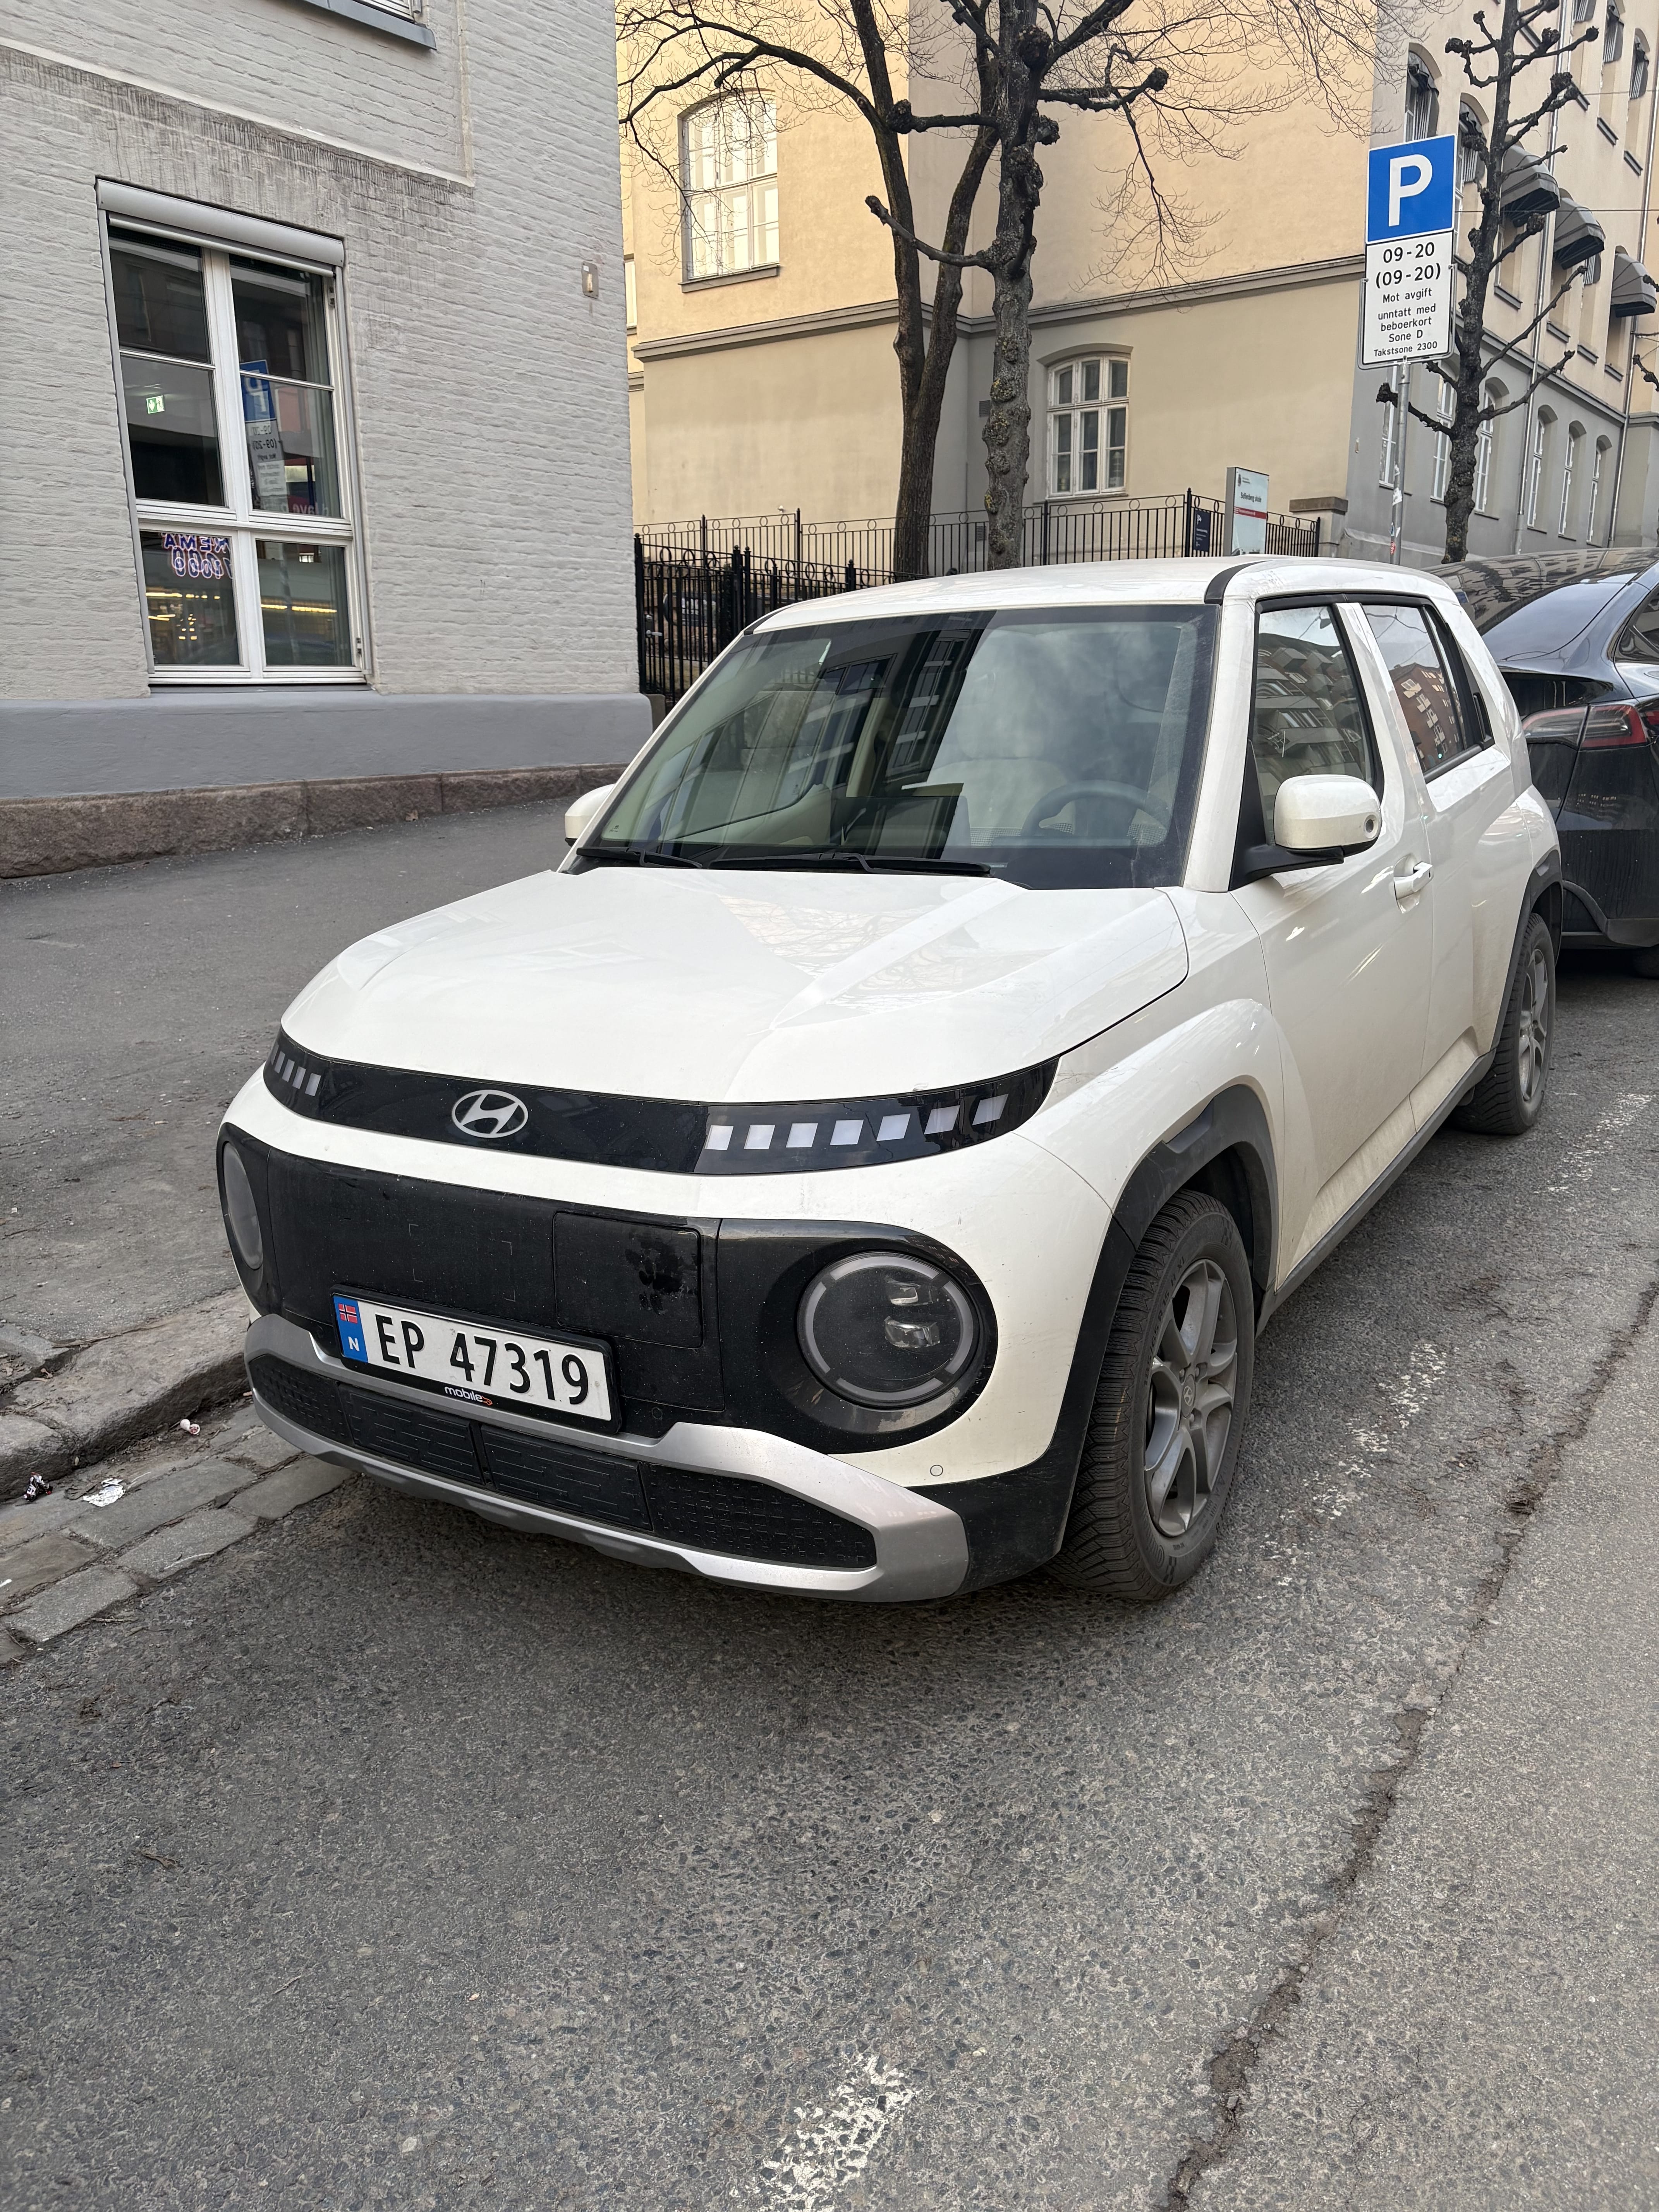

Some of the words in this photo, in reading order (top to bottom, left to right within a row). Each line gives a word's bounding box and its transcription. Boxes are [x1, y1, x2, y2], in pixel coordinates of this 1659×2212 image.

[1388, 154, 1433, 227] P
[1383, 242, 1435, 263] 09-20
[1376, 263, 1441, 289] (09-20)
[1382, 292, 1400, 303] Mot
[1405, 288, 1432, 300] avgift
[1378, 307, 1411, 320] unntatt
[1417, 303, 1436, 314] med
[1381, 316, 1432, 331] beboerkort
[1389, 333, 1411, 342] Sone
[1417, 330, 1423, 338] D
[1374, 346, 1413, 357] Takstsone
[1417, 341, 1437, 350] 2300
[349, 1337, 360, 1352] N
[375, 1314, 424, 1368] EP
[450, 1333, 588, 1405] 47319
[444, 1386, 483, 1402] mobile
